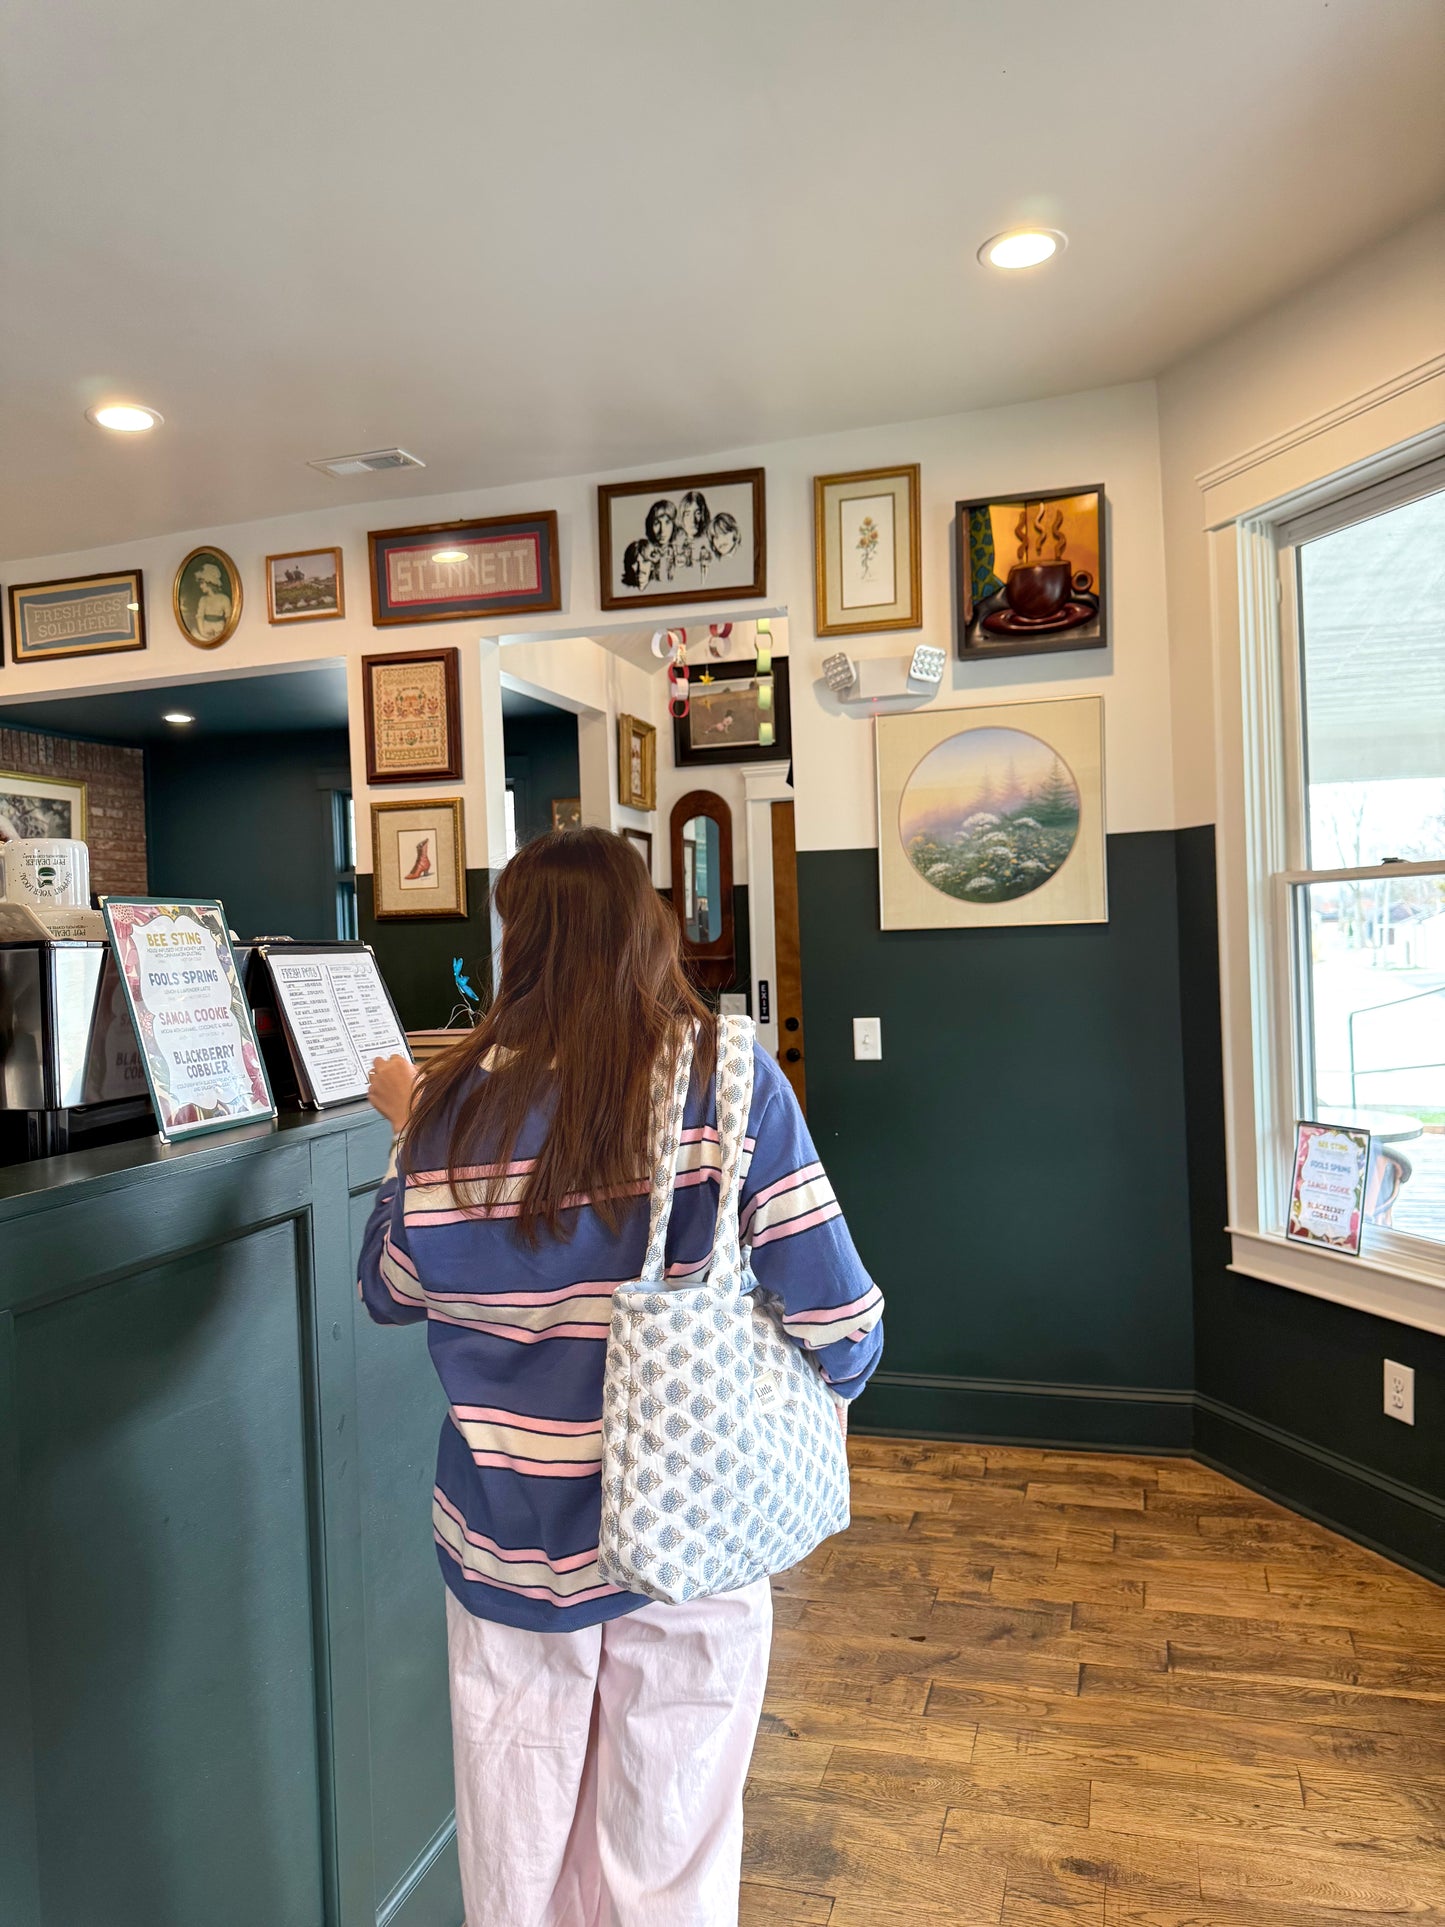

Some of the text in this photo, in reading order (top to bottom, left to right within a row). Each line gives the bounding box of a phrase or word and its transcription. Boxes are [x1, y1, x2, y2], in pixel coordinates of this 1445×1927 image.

[397, 549, 530, 593] STINNETT
[33, 599, 121, 623] FRESH EGGS
[38, 613, 117, 638] SOLD HERE
[33, 888, 52, 897] YOUR
[54, 871, 72, 896] SUPPORT
[146, 932, 202, 946] BEE STING
[149, 970, 218, 986] FOOLS SPRING
[159, 1007, 229, 1025] SAMOA COOKIE
[174, 1044, 235, 1064] BLACKBERRY
[187, 1060, 230, 1079] COBBLER
[755, 1384, 772, 1398] Little
